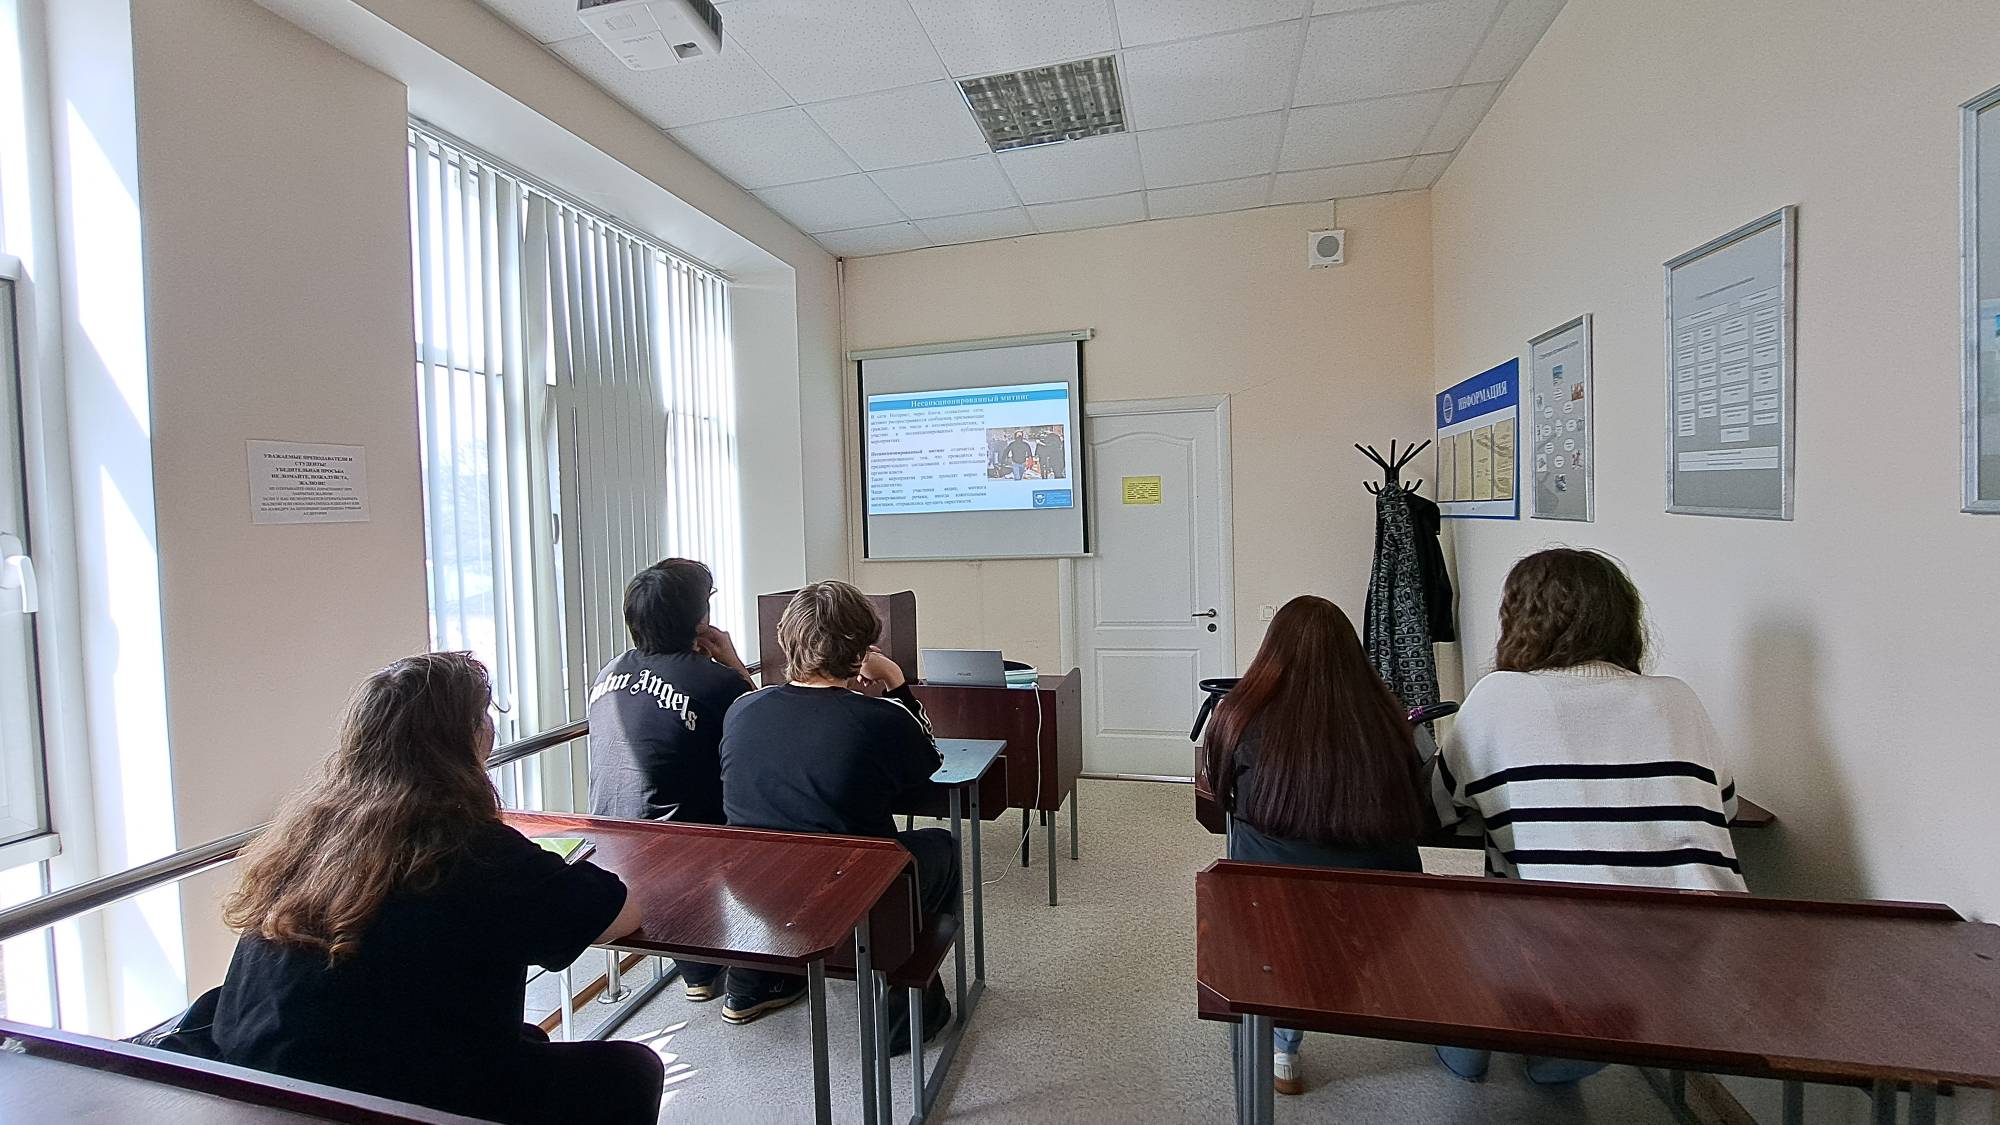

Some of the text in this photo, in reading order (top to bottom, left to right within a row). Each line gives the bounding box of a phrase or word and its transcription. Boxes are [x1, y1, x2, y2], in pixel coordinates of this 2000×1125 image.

[911, 394, 1029, 408] Несанкционированный митинг
[1457, 381, 1508, 411] ИНФОРМАЦИЯ
[589, 669, 698, 731] alm Angels
